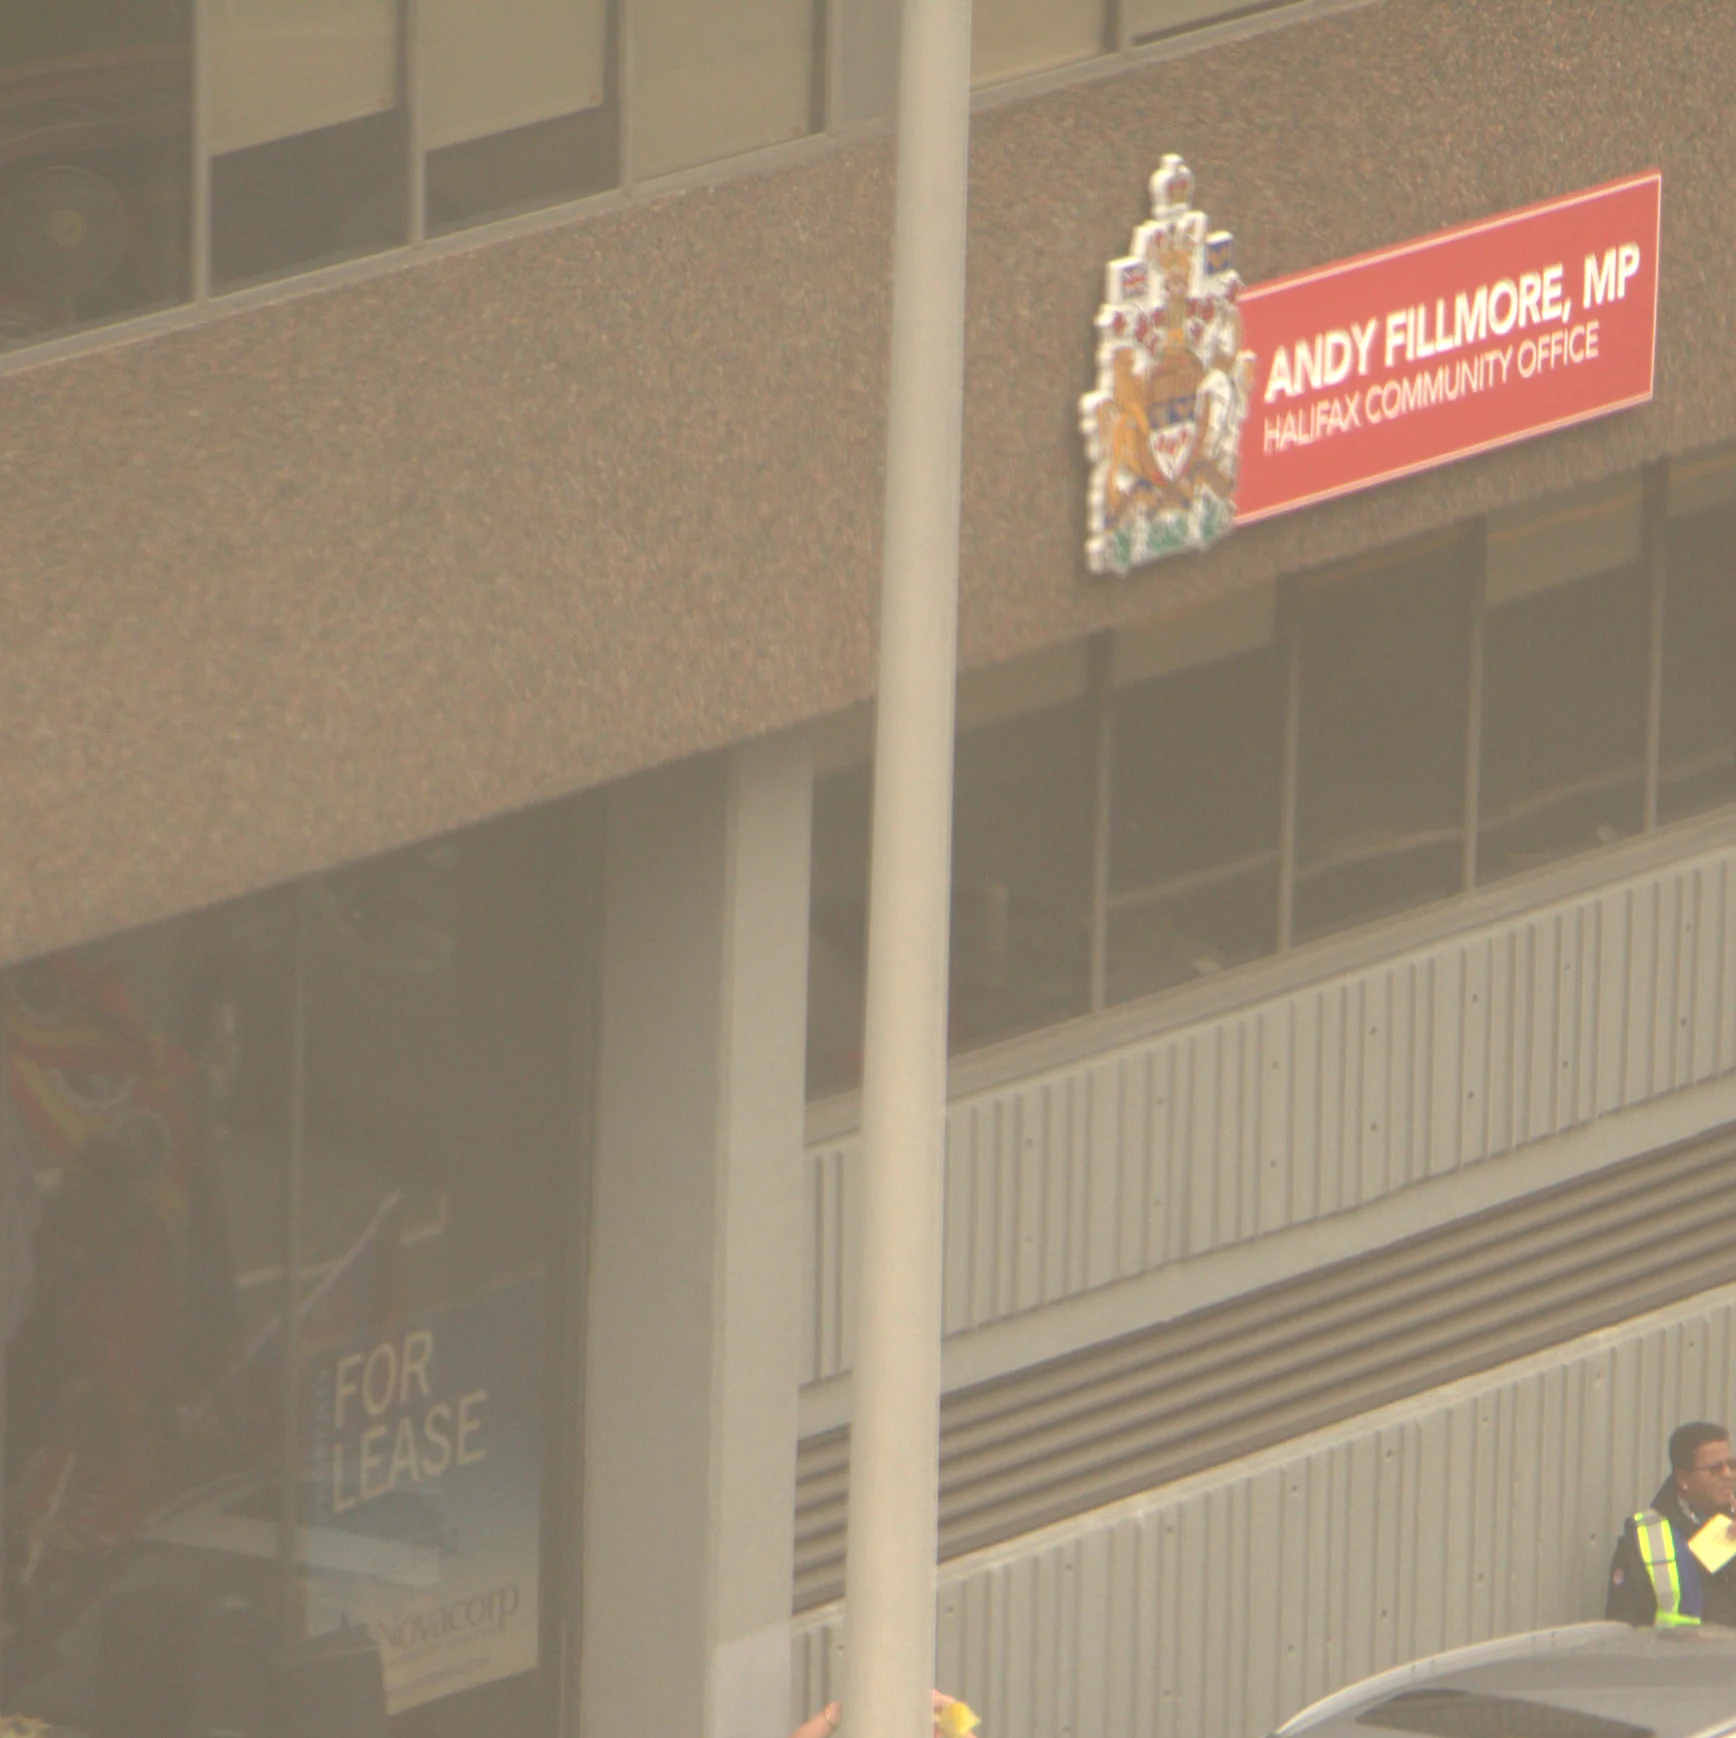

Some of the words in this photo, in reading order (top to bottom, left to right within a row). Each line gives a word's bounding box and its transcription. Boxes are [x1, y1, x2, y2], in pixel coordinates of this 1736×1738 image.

[1263, 393, 1361, 455] HALIFAX
[1364, 349, 1513, 426] COMMUNITY
[1516, 320, 1600, 381] OFFICE
[1264, 317, 1379, 403] ANDY
[1385, 264, 1572, 366] FILLMORE,
[1582, 243, 1640, 309] MP
[334, 1330, 434, 1429] FOR
[332, 1389, 488, 1514] LEASE
